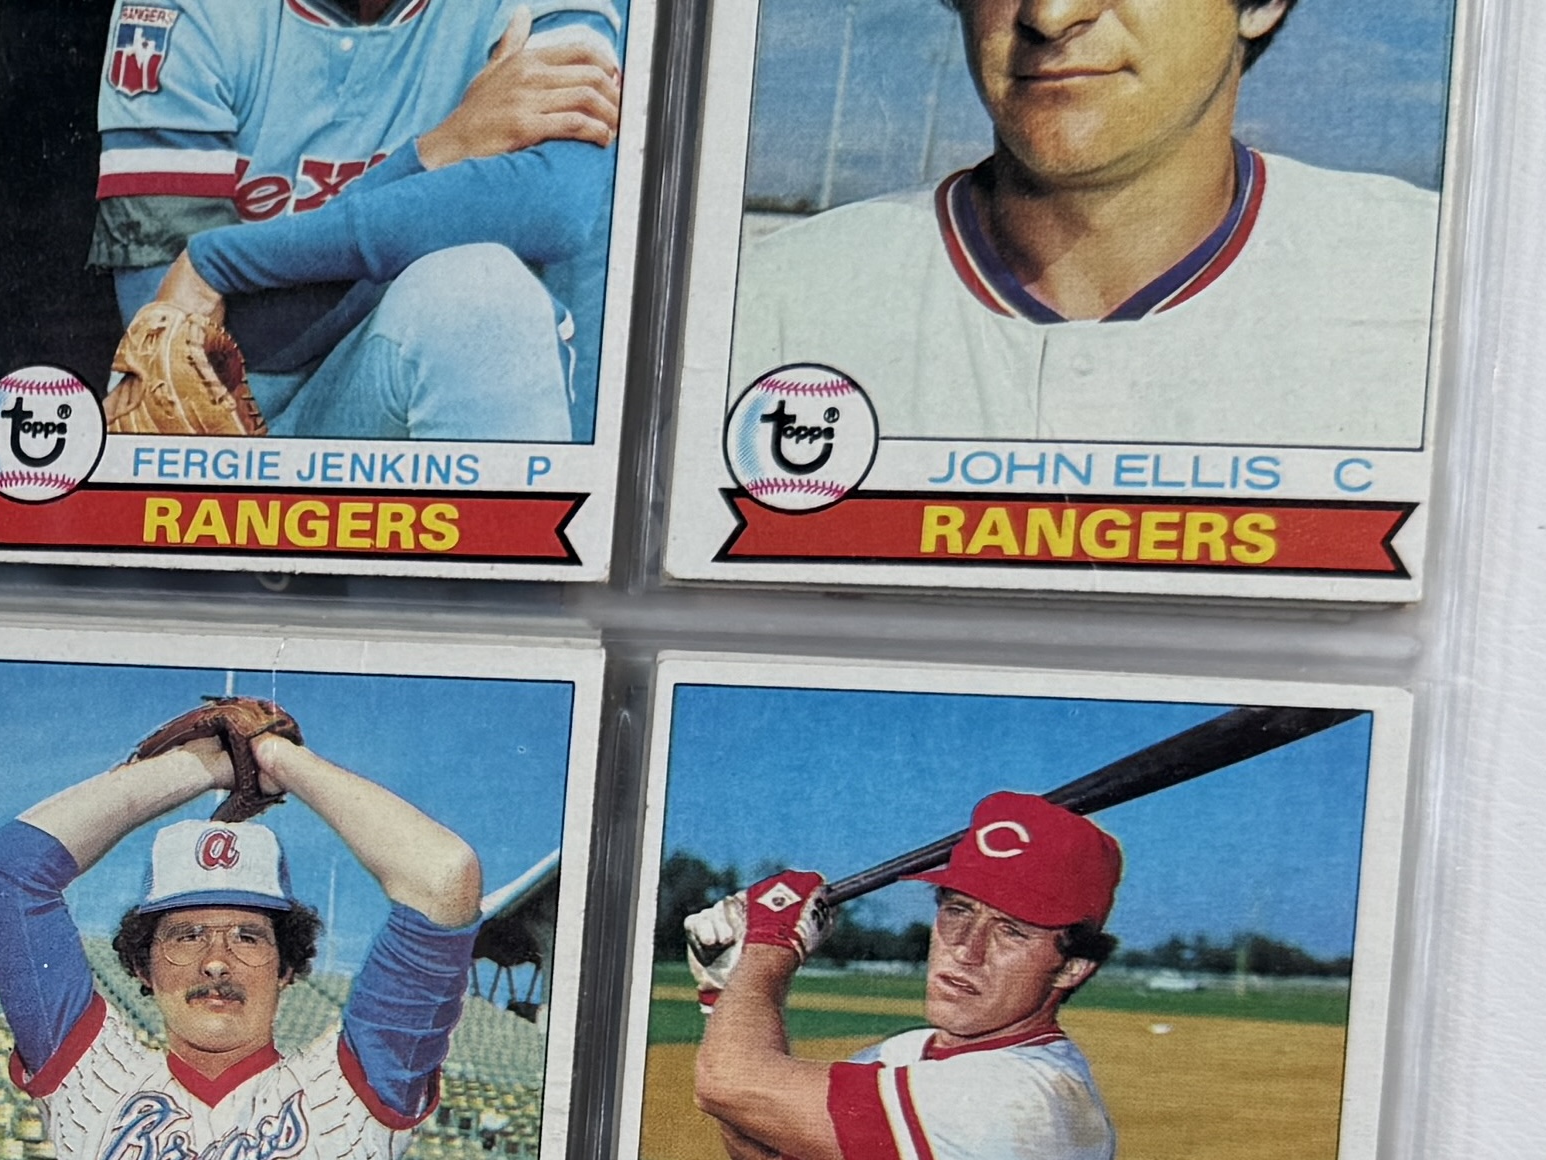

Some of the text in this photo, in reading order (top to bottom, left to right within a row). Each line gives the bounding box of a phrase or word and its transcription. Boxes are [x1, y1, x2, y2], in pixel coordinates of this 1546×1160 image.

[1, 397, 67, 468] topps
[760, 400, 837, 476] topps
[132, 447, 553, 486] FERGIE JENKINS P
[927, 451, 1373, 493] JOHN ELLIS C
[142, 497, 461, 551] RANGERS
[919, 505, 1278, 564] RANGERS
[975, 821, 1030, 858] C
